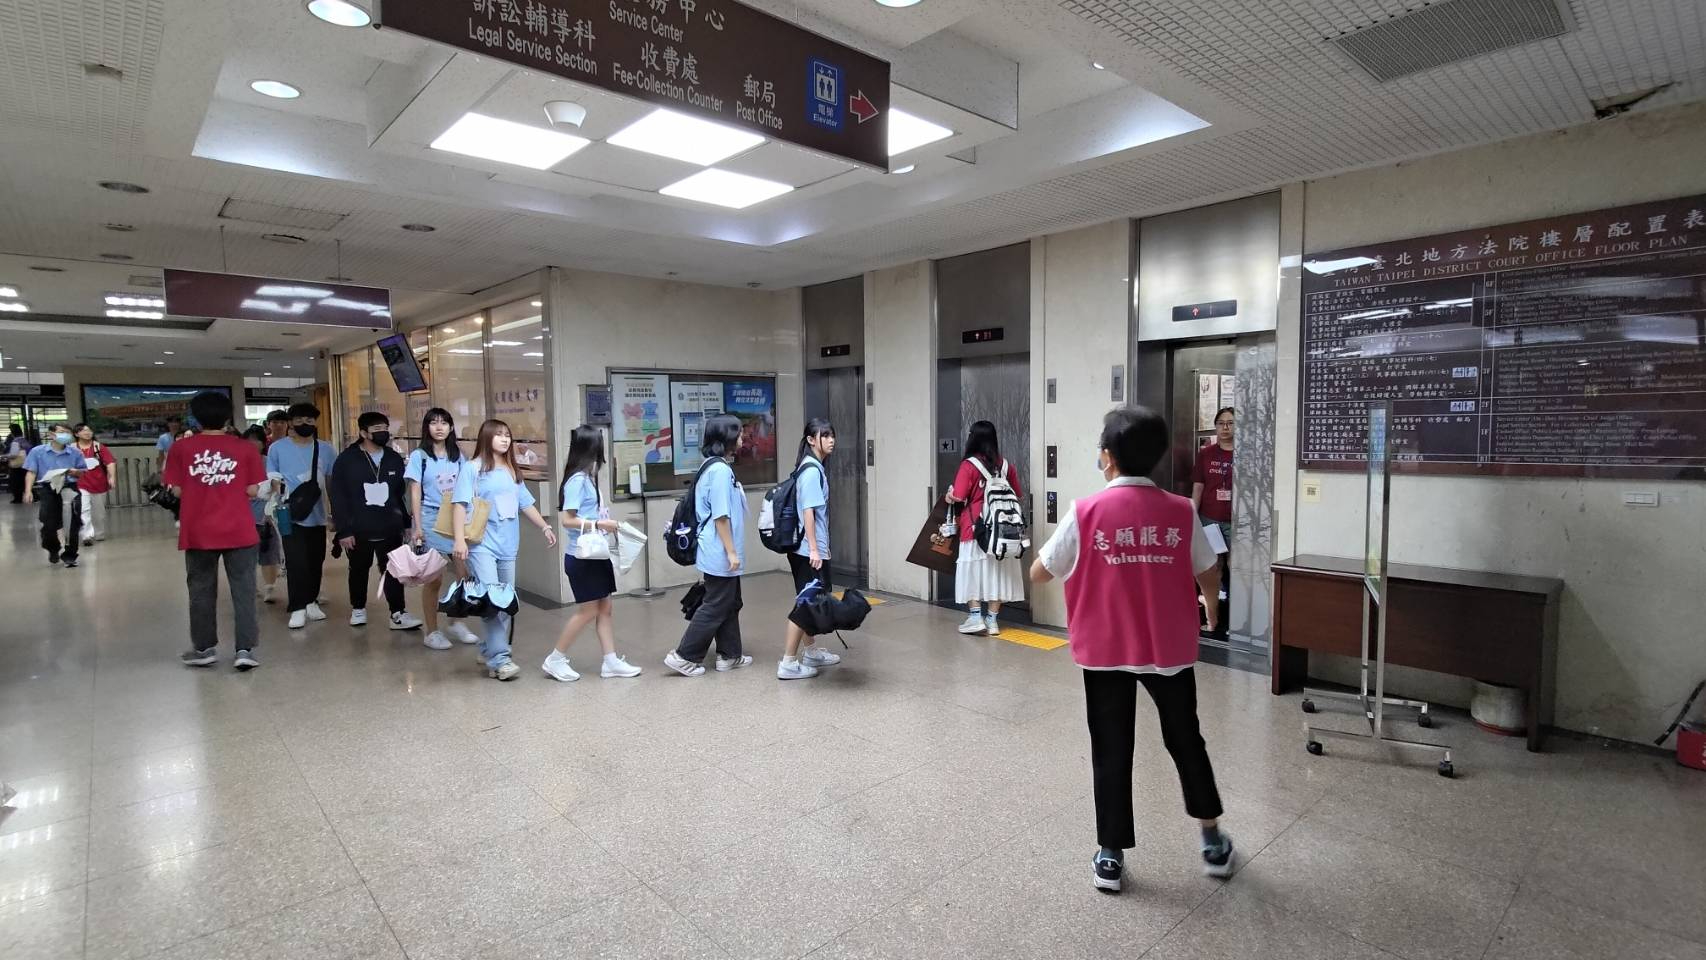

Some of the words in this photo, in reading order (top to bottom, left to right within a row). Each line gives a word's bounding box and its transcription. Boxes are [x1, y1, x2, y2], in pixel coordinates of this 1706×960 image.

[473, 0, 596, 52] 訴訟輔導科
[609, 0, 648, 31] Service
[650, 15, 684, 43] Center
[469, 17, 502, 47] Legal
[506, 29, 552, 61] Service
[555, 44, 598, 76] Section
[641, 41, 700, 85] 收費處
[613, 62, 685, 101] Fee-Collection
[687, 86, 723, 112] Counter
[744, 73, 776, 109] 郵局
[736, 100, 756, 122] Post
[758, 108, 783, 130] Office
[813, 113, 838, 128] Elevator
[1323, 208, 1706, 277] 臺北地方法院樓層配置表
[1334, 274, 1371, 288] TAIWAN
[1377, 269, 1416, 282] TAIPEI
[1423, 261, 1482, 276] DISTRICT
[1488, 255, 1528, 269] COURT
[1535, 248, 1586, 263] OFFICE
[1595, 241, 1640, 255] FLOOR
[1649, 235, 1688, 249] PLAN
[1094, 526, 1182, 550] 志願服務
[1104, 552, 1175, 565] Volunteer
